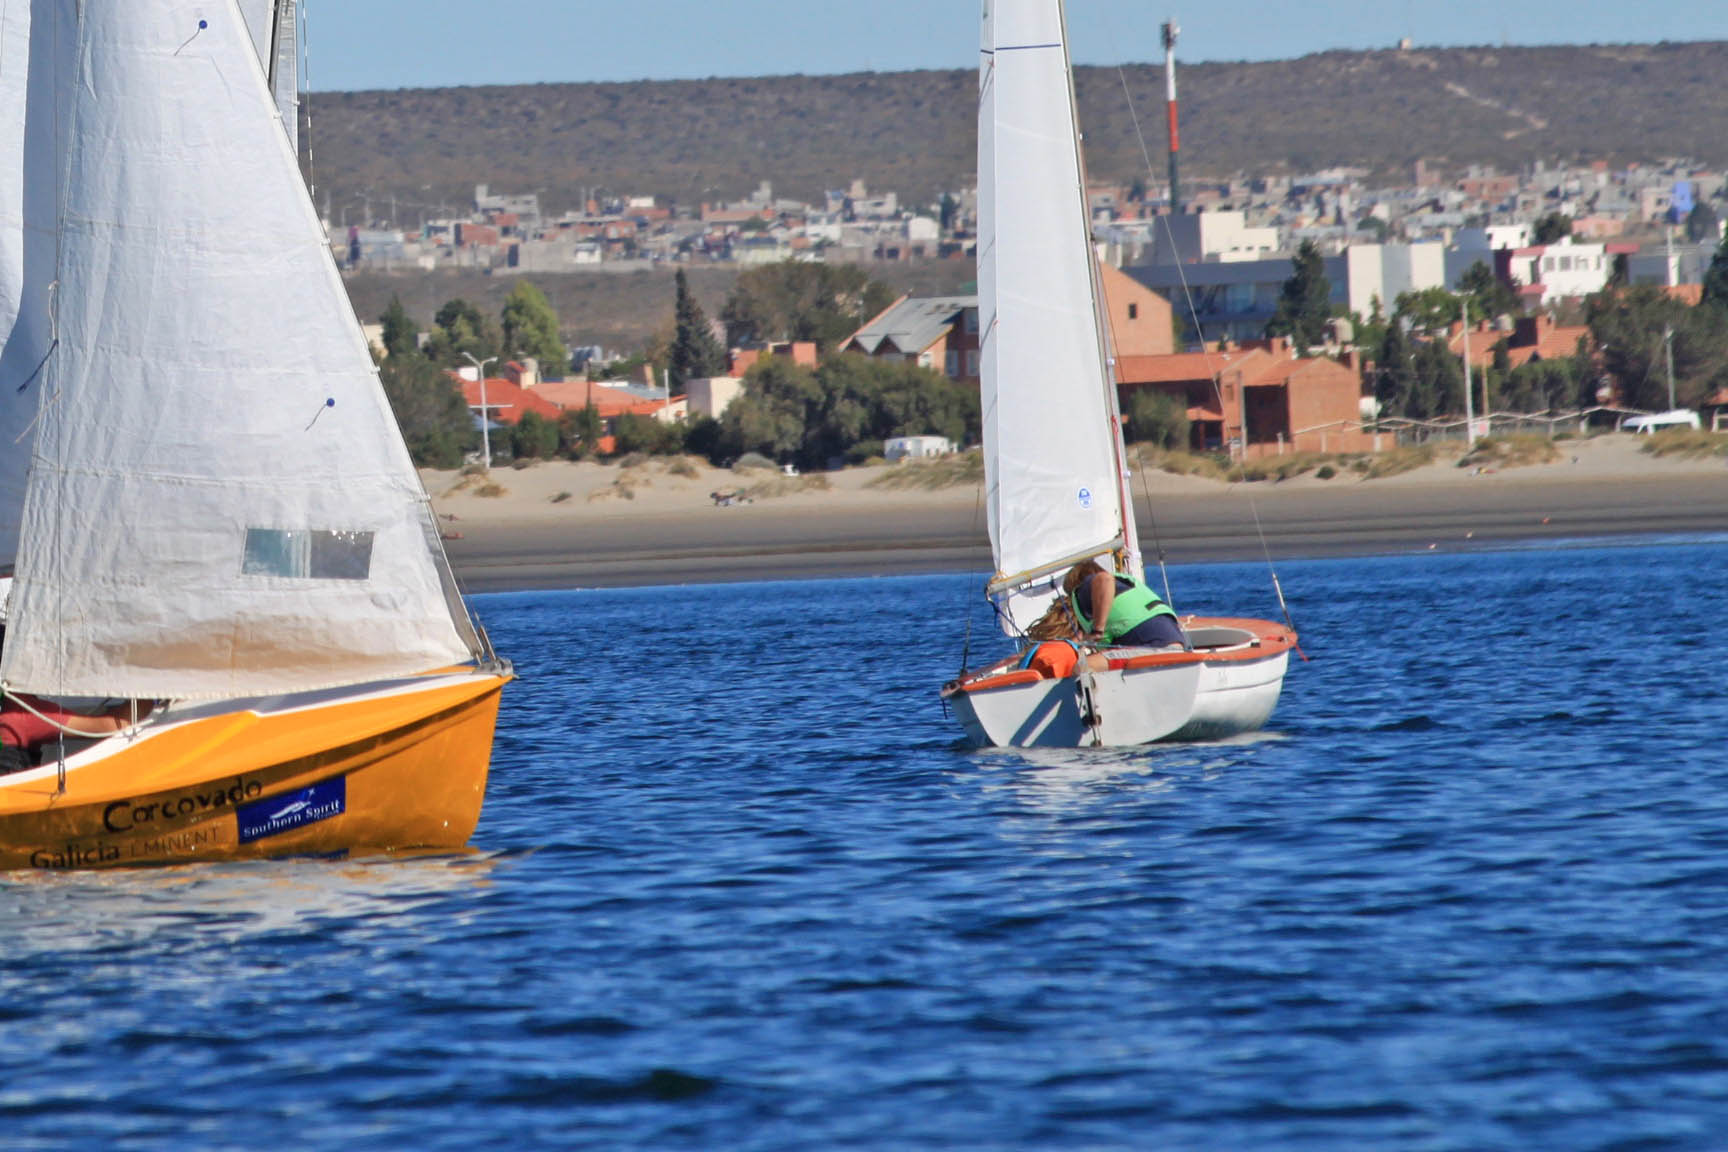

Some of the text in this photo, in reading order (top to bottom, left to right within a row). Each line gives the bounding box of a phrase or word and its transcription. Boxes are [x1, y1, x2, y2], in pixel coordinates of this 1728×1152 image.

[103, 777, 262, 833] Corcovado
[243, 812, 301, 837] Southern
[305, 799, 340, 819] Spirit
[29, 841, 121, 868] Galicia
